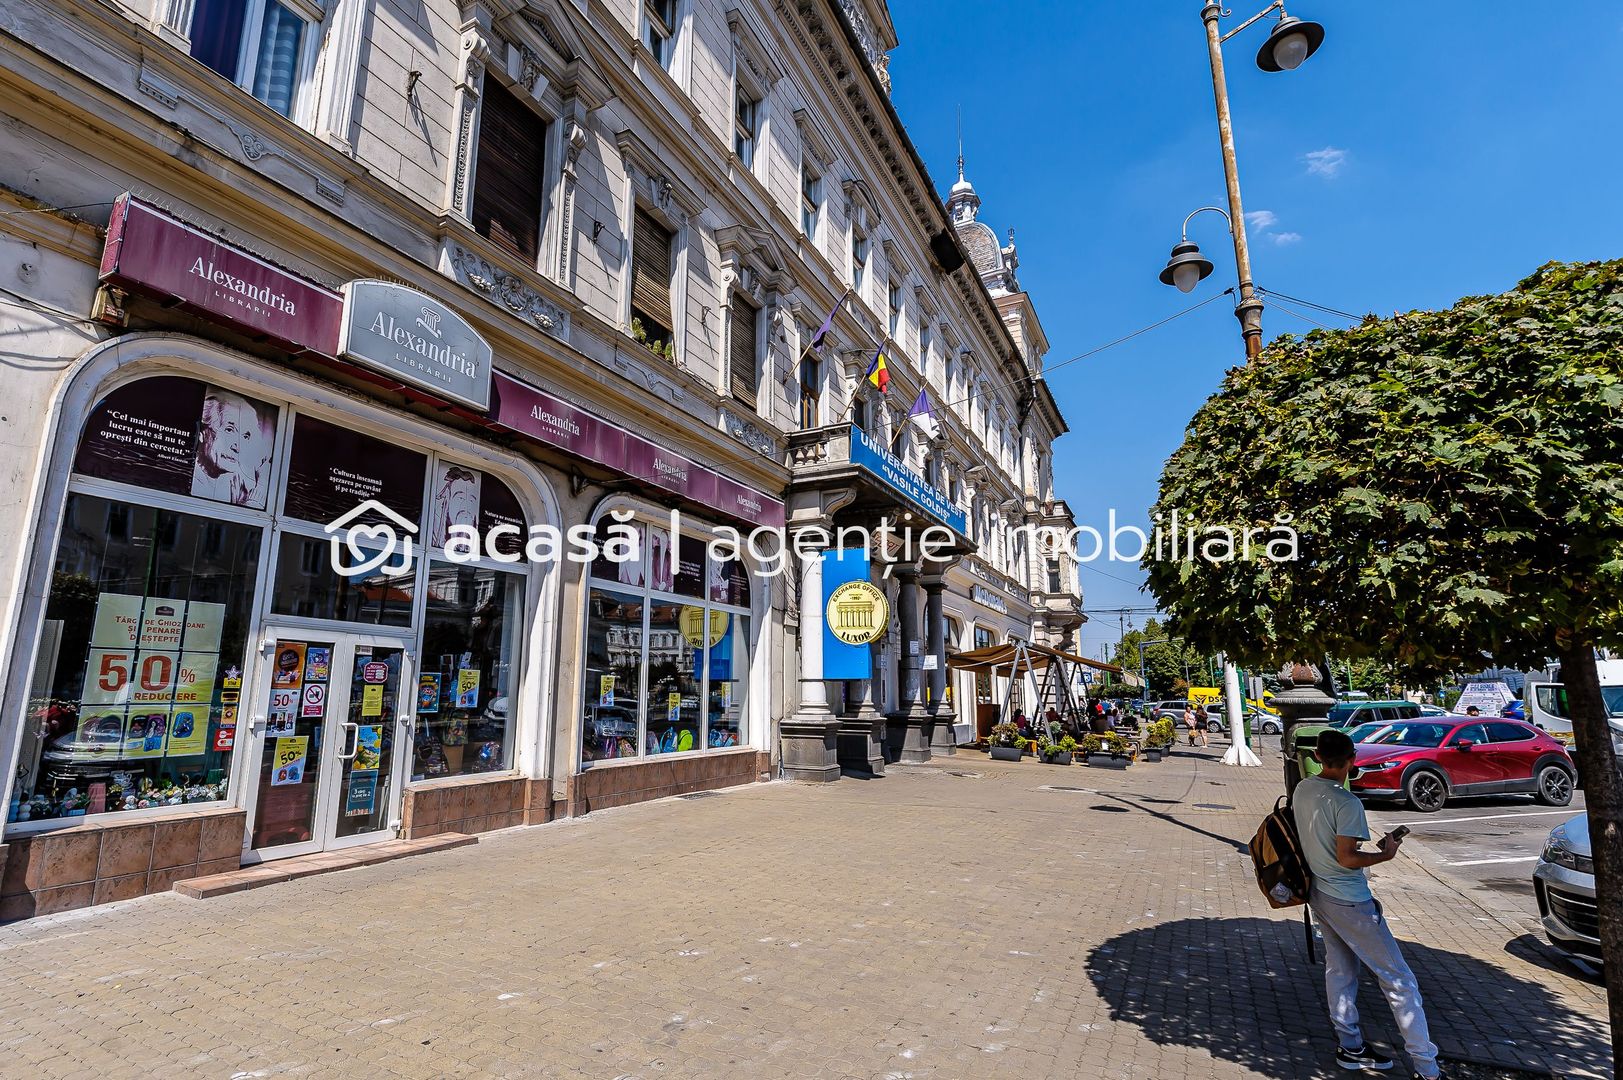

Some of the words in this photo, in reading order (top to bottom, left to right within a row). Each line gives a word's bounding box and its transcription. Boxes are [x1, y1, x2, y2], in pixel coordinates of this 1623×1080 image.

[189, 256, 296, 316] Alexandria
[369, 311, 477, 379] Alexandria
[130, 417, 147, 427] mai
[148, 420, 191, 437] important
[530, 404, 580, 436] Alexandria
[100, 430, 132, 442] oprești
[133, 437, 148, 447] din
[109, 420, 133, 432] lucru
[135, 427, 152, 437] este
[153, 432, 163, 440] să
[178, 438, 186, 446] te
[652, 457, 687, 482] Alexandria
[860, 431, 934, 497] UNIVERSITATEA
[935, 490, 945, 505] DE
[946, 499, 963, 518] VEST
[355, 481, 362, 489] pe
[833, 584, 861, 602] EXCHANGE
[862, 585, 880, 601] OFFICE
[146, 626, 181, 635] PENARE
[841, 631, 871, 642] LUXOR
[134, 692, 197, 701] REDUCERE
[281, 750, 302, 765] 50%
